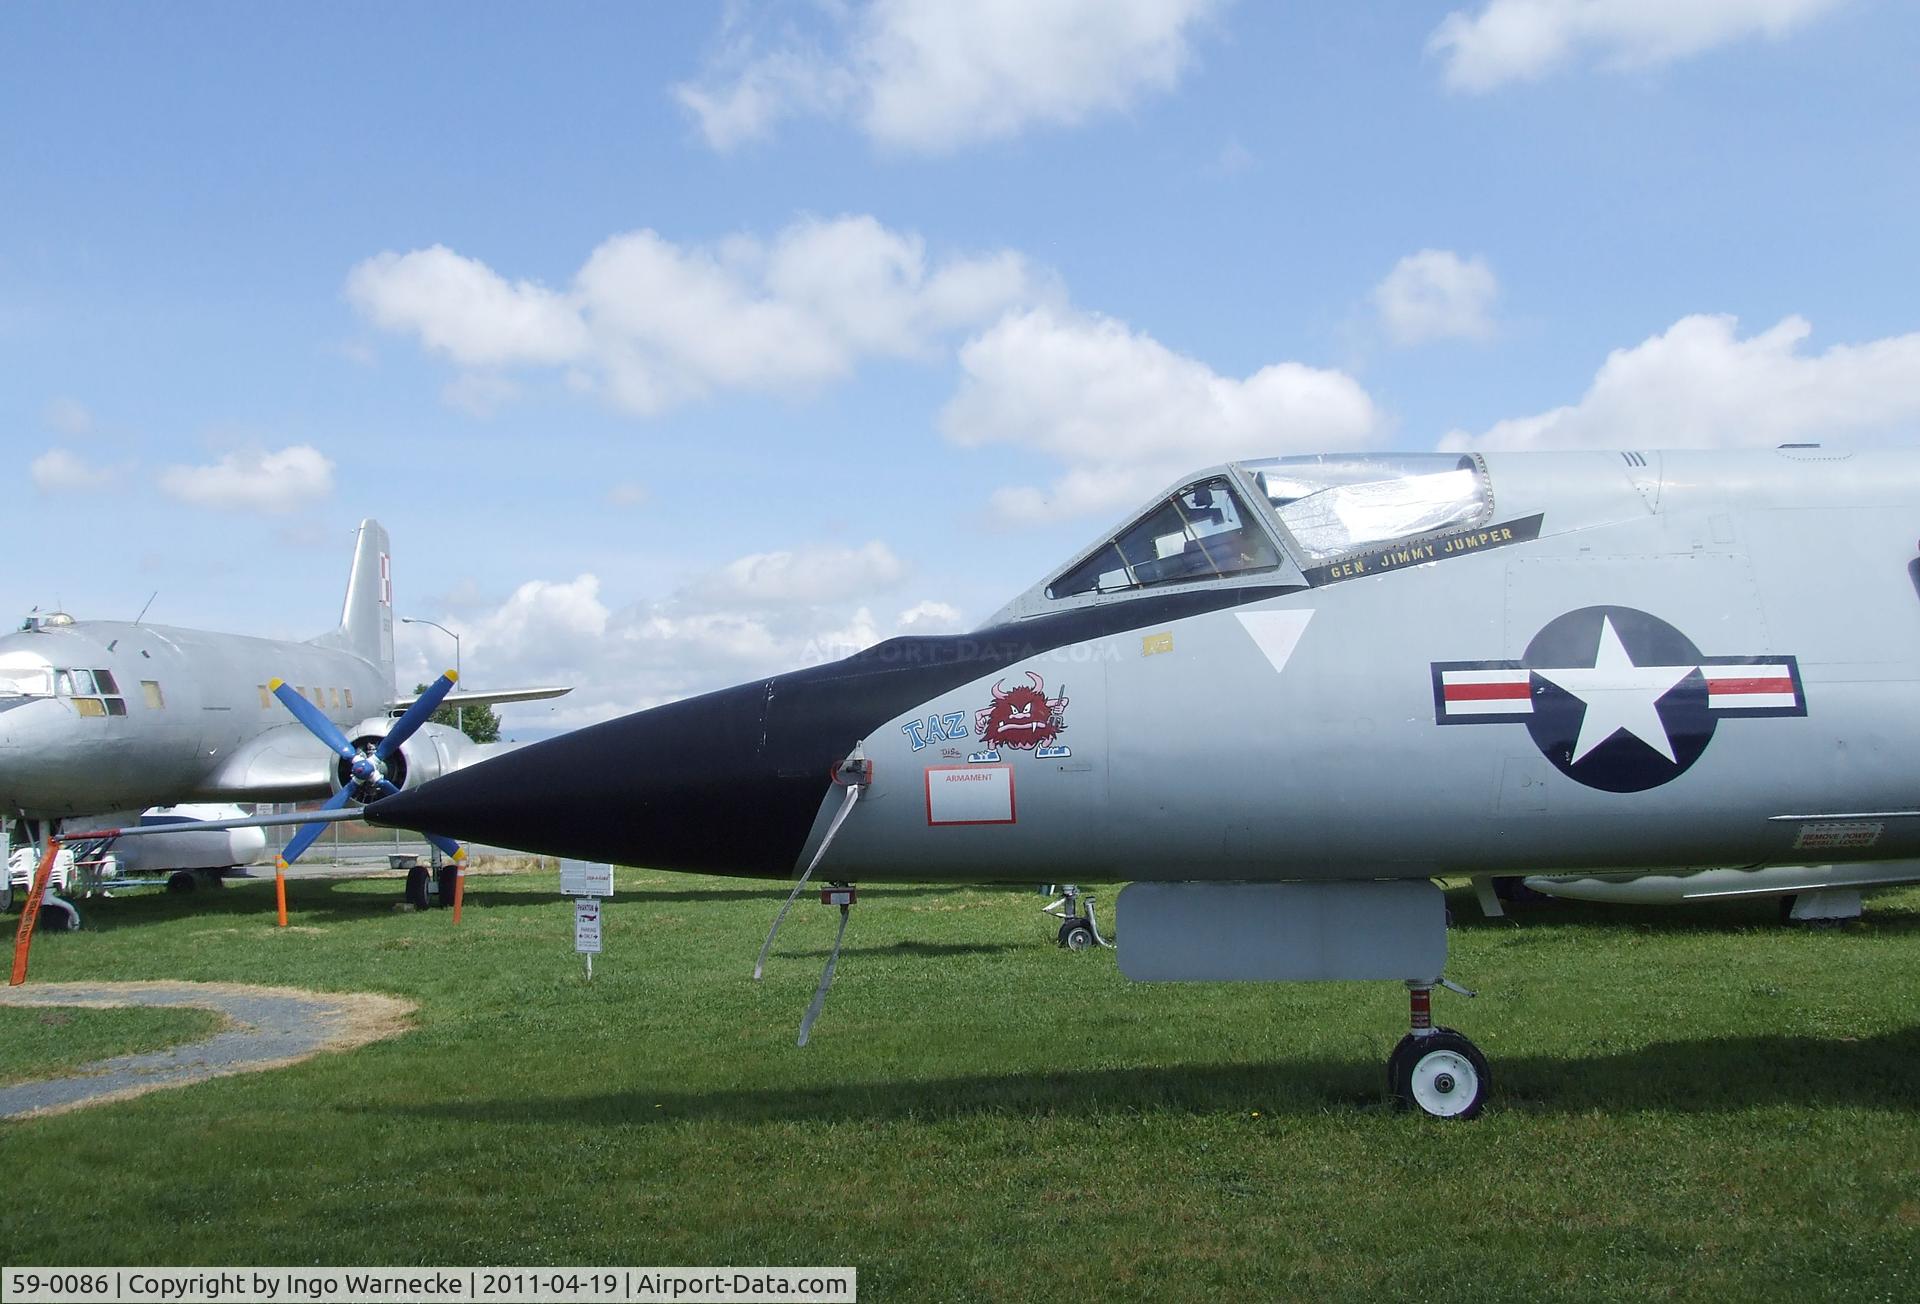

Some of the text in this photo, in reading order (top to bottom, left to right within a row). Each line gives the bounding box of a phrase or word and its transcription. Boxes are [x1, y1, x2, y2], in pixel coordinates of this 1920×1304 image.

[1330, 527, 1513, 579] GEN. JIMMY JUMPER
[902, 710, 969, 752] TAZ
[945, 773, 993, 783] ARMAMENT
[1802, 832, 1840, 840] REMOVE
